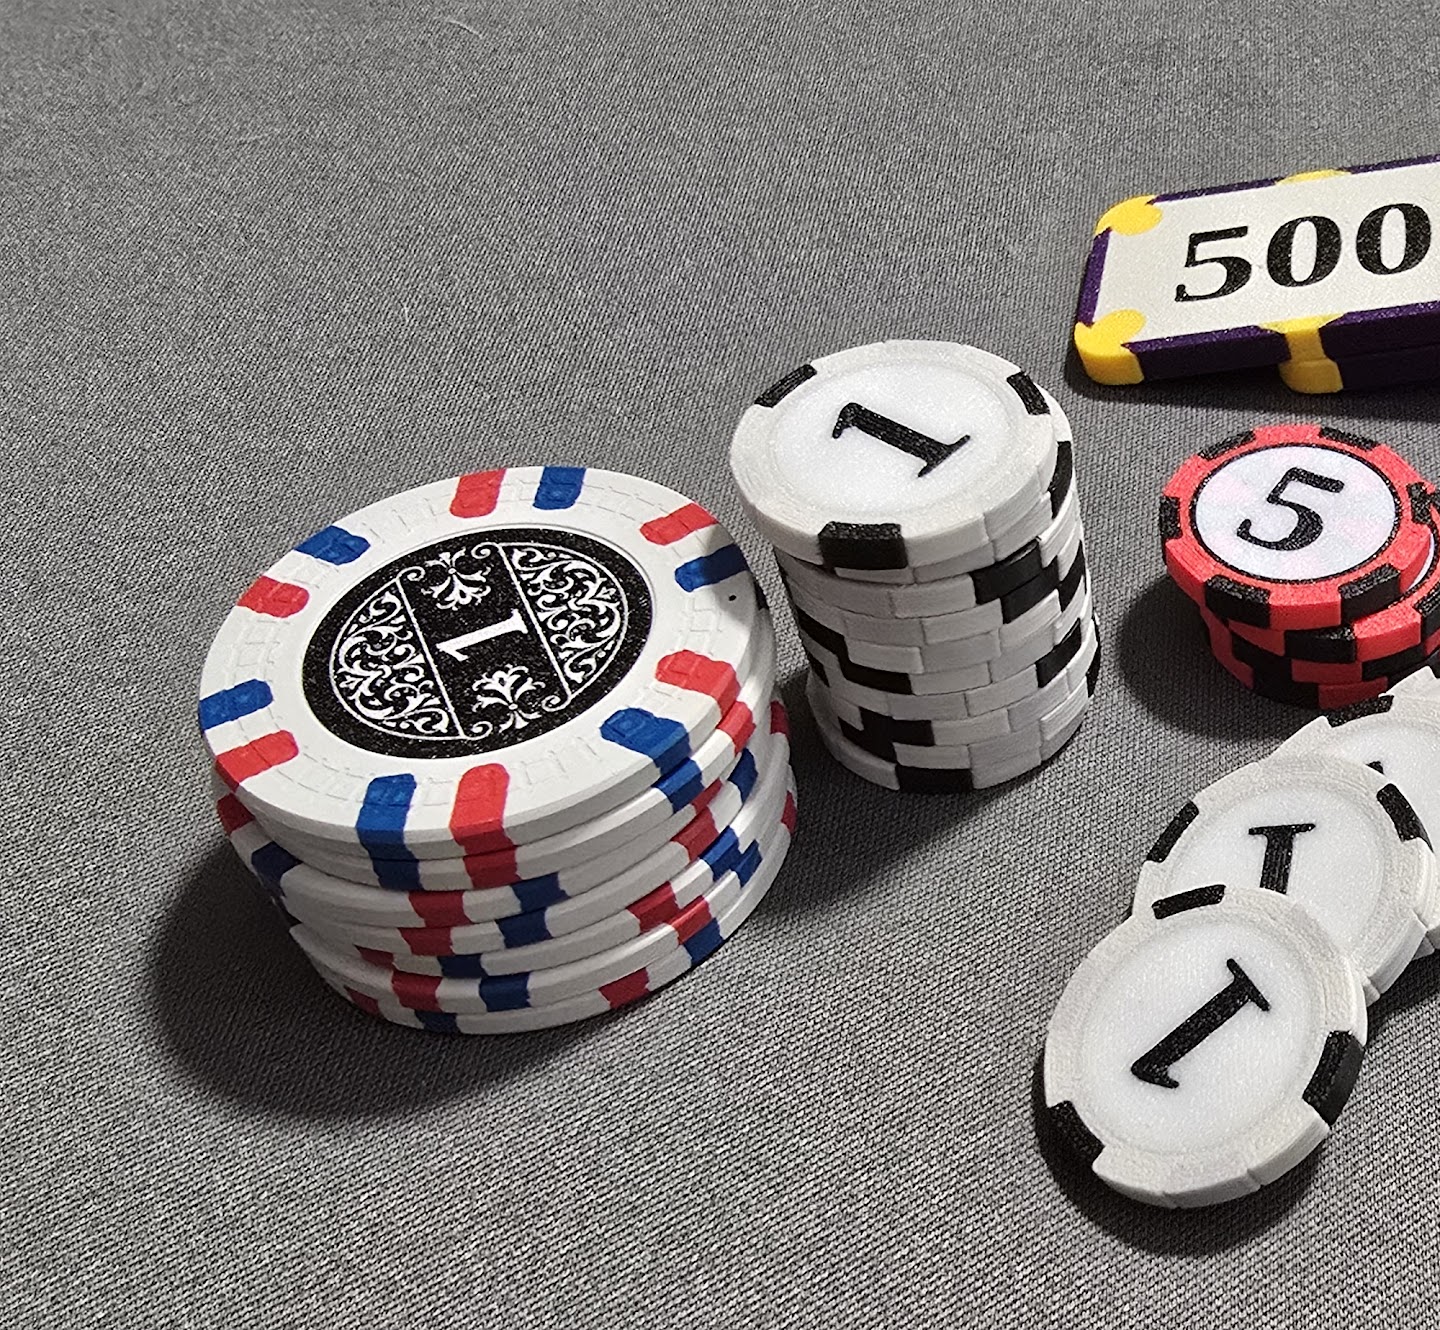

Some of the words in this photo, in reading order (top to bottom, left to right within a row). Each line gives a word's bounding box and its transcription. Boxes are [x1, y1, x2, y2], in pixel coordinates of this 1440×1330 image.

[1174, 203, 1432, 303] 500
[832, 401, 971, 478] 1
[1236, 466, 1345, 552] 5
[435, 608, 529, 662] 1
[1130, 958, 1271, 1089] 1
